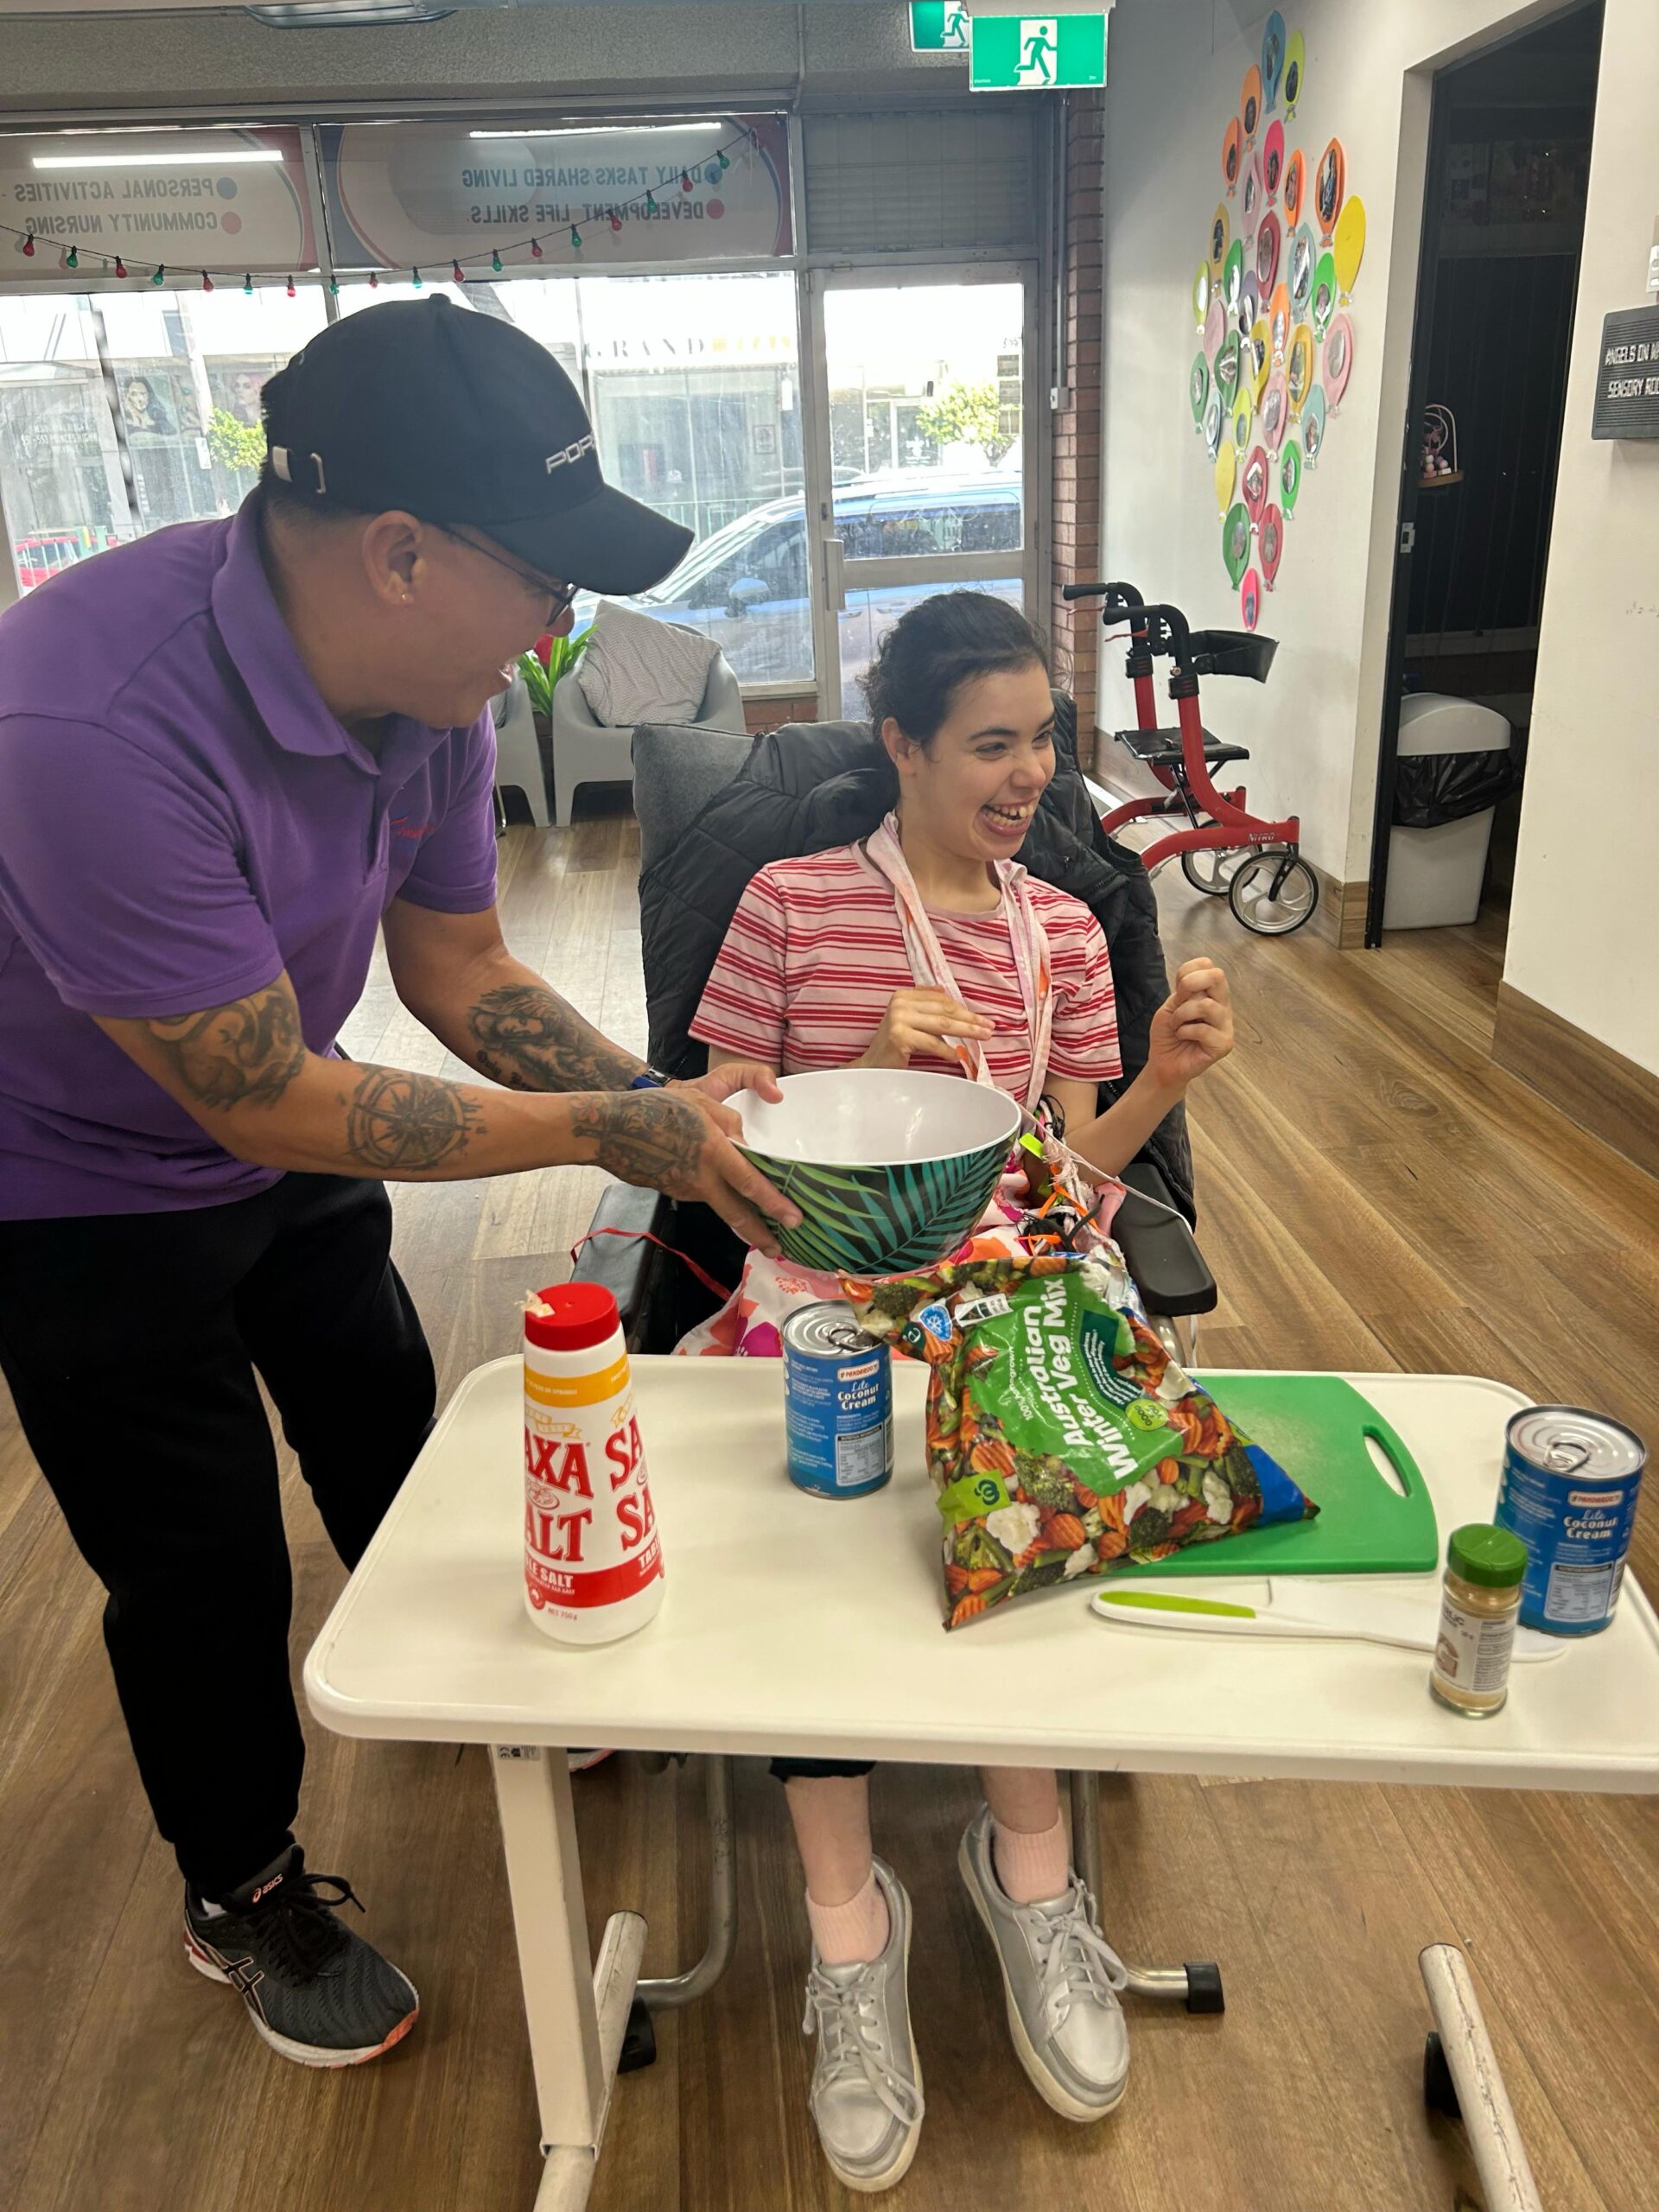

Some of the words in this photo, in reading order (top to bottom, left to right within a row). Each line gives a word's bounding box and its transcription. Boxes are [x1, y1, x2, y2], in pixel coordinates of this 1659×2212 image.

[1605, 346, 1636, 366] ANGELS
[1637, 344, 1649, 361] ON
[1607, 378, 1644, 398] SENSORY
[1040, 1278, 1067, 1327] Mix
[1048, 1334, 1078, 1390] Veg
[1023, 1306, 1095, 1446] Australian
[837, 1382, 880, 1402] Coconut
[841, 1395, 876, 1412] Cream
[1069, 1393, 1139, 1480] Winter
[1563, 1516, 1618, 1529] Coconut
[1566, 1527, 1612, 1540] Cream
[540, 1567, 574, 1588] SALT
